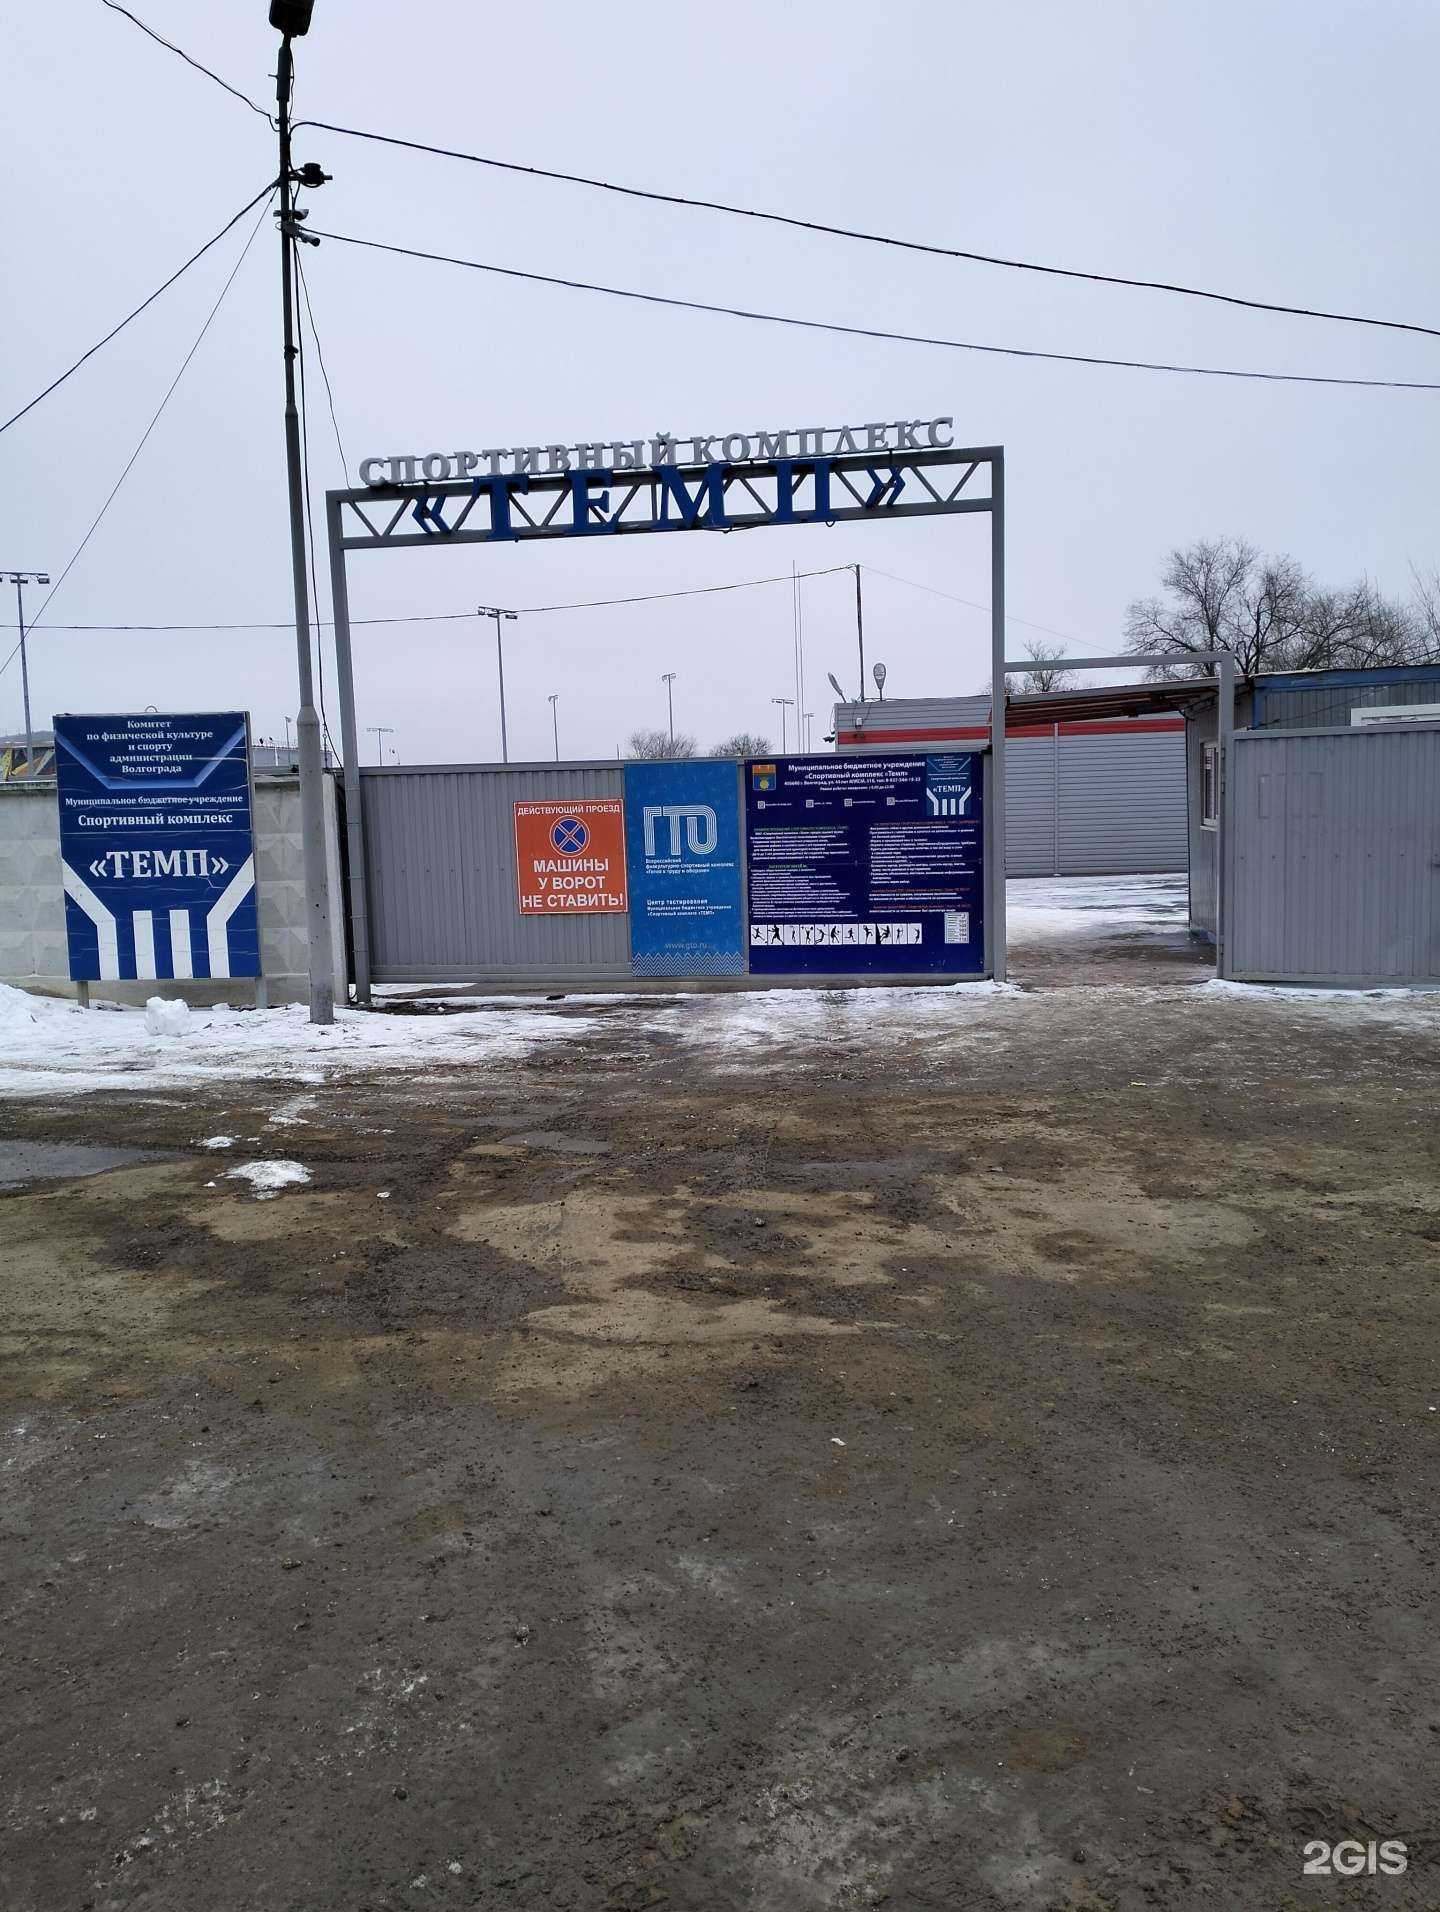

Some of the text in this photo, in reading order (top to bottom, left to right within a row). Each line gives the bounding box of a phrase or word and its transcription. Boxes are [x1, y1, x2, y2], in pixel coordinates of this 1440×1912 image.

[359, 416, 954, 487] СПОРТИВНЫЙ КОМПЛЕКС
[411, 459, 907, 541] «ТЕМП»
[127, 720, 172, 729] Комитет
[86, 731, 213, 742] по физической культуре
[137, 743, 172, 752] спорту
[109, 754, 193, 763] администрации
[122, 765, 182, 774] Волгограда
[788, 764, 842, 772] Муниципальное
[883, 761, 925, 770] учреждение
[65, 795, 243, 807] Муниципальное бюджетное учреждение
[517, 804, 620, 816] ДЕЙСТВУЮЩИЙ ПРОЕЗД
[78, 813, 233, 827] Спортивный комплекс
[643, 805, 718, 856] ГТО
[89, 850, 229, 879] «ТЕМП»
[533, 858, 609, 872] МАШИНЫ
[538, 876, 606, 890] У ВОРОТ
[522, 893, 624, 908] НЕ СТАВИТЬ!
